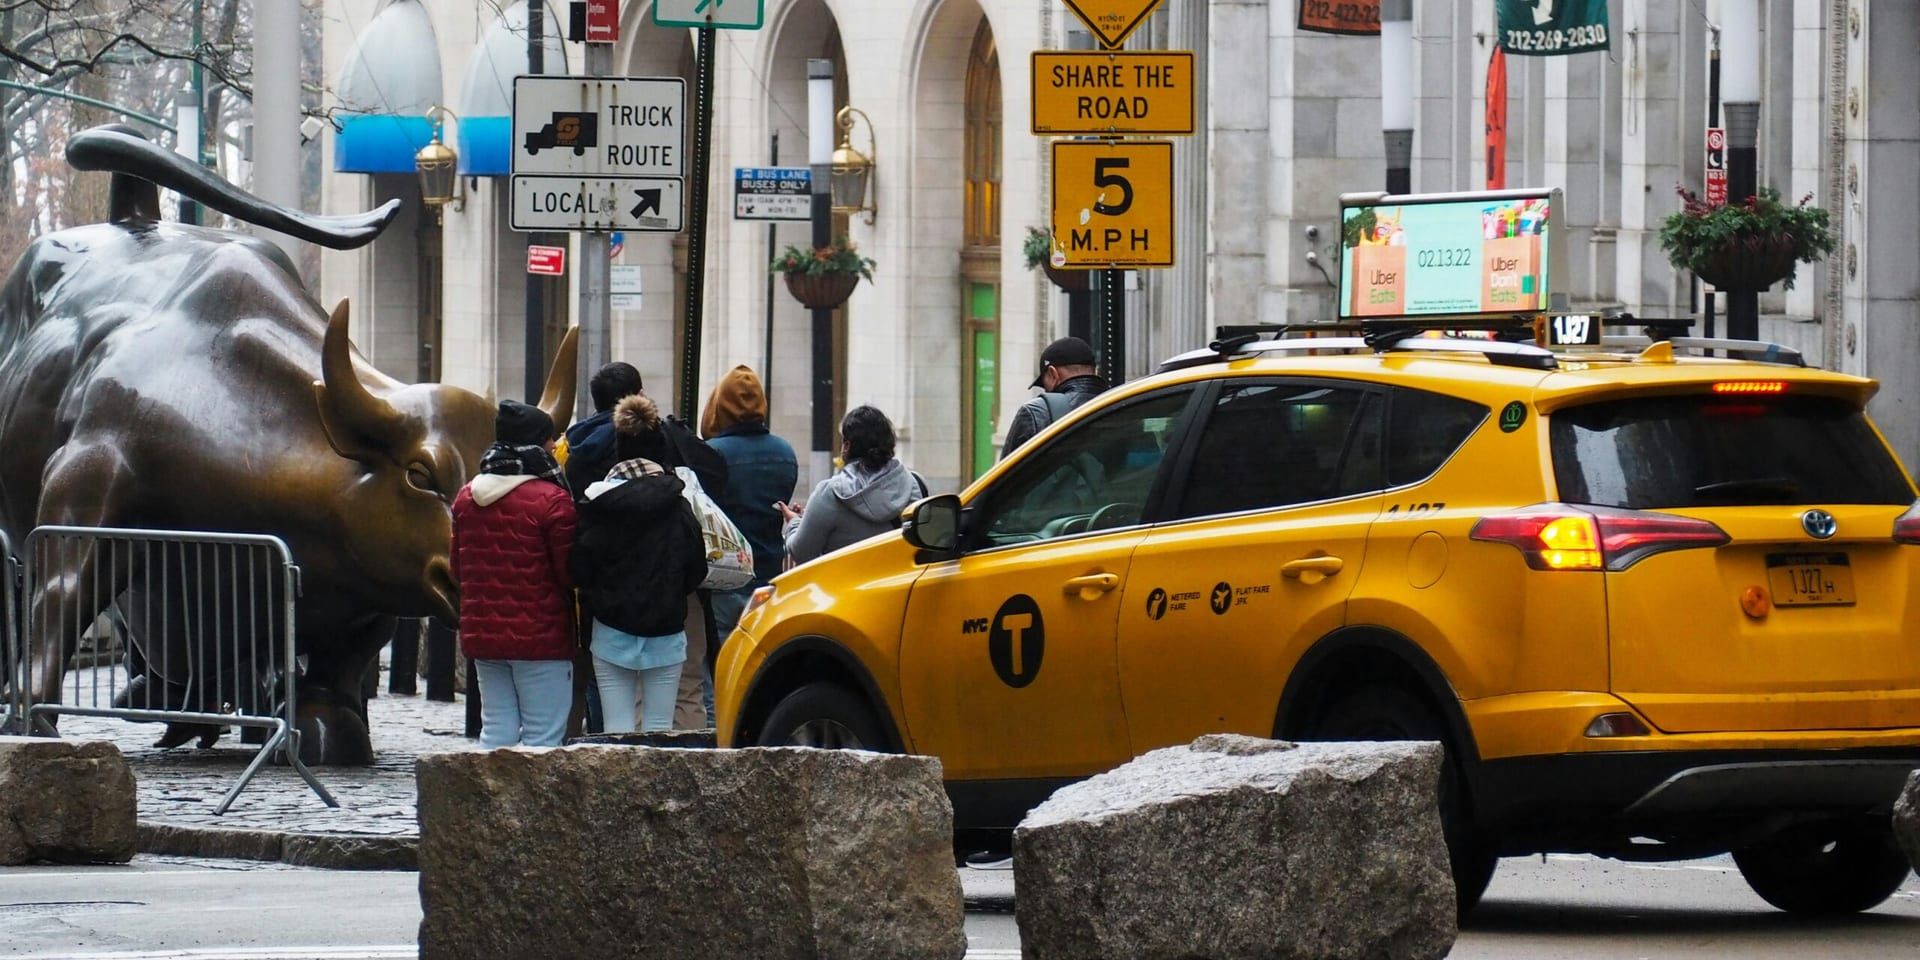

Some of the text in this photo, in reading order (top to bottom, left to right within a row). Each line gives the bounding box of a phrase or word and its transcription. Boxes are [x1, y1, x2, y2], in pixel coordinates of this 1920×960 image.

[1306, 1, 1381, 24] 212-422-22
[1506, 24, 1606, 50] 212-269-2830
[1052, 65, 1174, 88] SHARE THE
[609, 105, 673, 127] TRUCK
[1078, 96, 1149, 119] ROAD
[608, 145, 673, 166] ROUTE
[742, 180, 807, 190] BUSES ONLY
[757, 170, 808, 180] BUS LANE
[1093, 157, 1134, 216] 5
[532, 192, 600, 213] LOCAL
[1418, 248, 1472, 268] 02.13.22
[1490, 257, 1518, 272] Uber
[1370, 269, 1397, 285] Uber
[1369, 288, 1397, 304] Eats
[1490, 288, 1518, 304] Eats
[1554, 315, 1590, 345] 1J27
[1170, 592, 1200, 601] METERED
[1235, 585, 1271, 596] FLAT FARE
[1170, 602, 1187, 611] FARE
[1235, 597, 1248, 605] JFK
[963, 612, 1033, 675] NYC T
